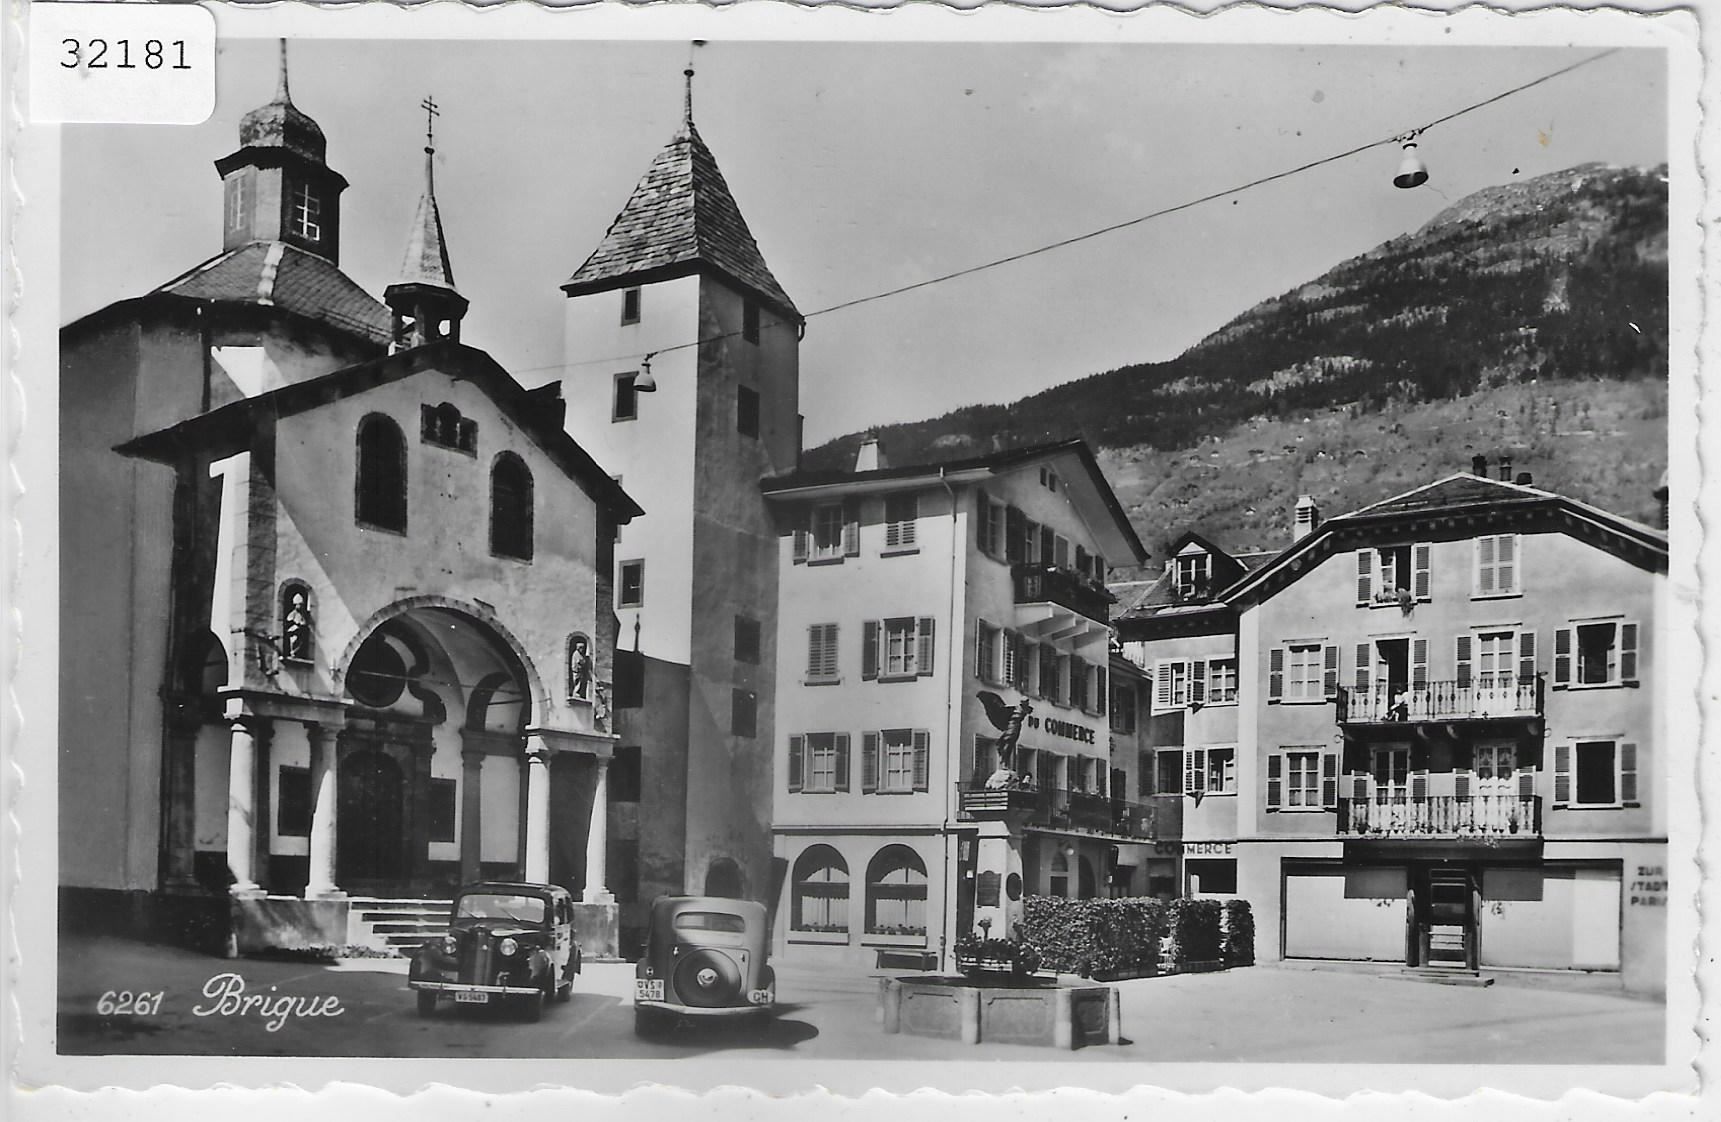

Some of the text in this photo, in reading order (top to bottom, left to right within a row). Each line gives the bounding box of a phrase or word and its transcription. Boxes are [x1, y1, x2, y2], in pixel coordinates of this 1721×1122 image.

[1044, 717, 1096, 745] COMMERCE
[1637, 865, 1663, 877] ZUR
[753, 991, 768, 1003] CH
